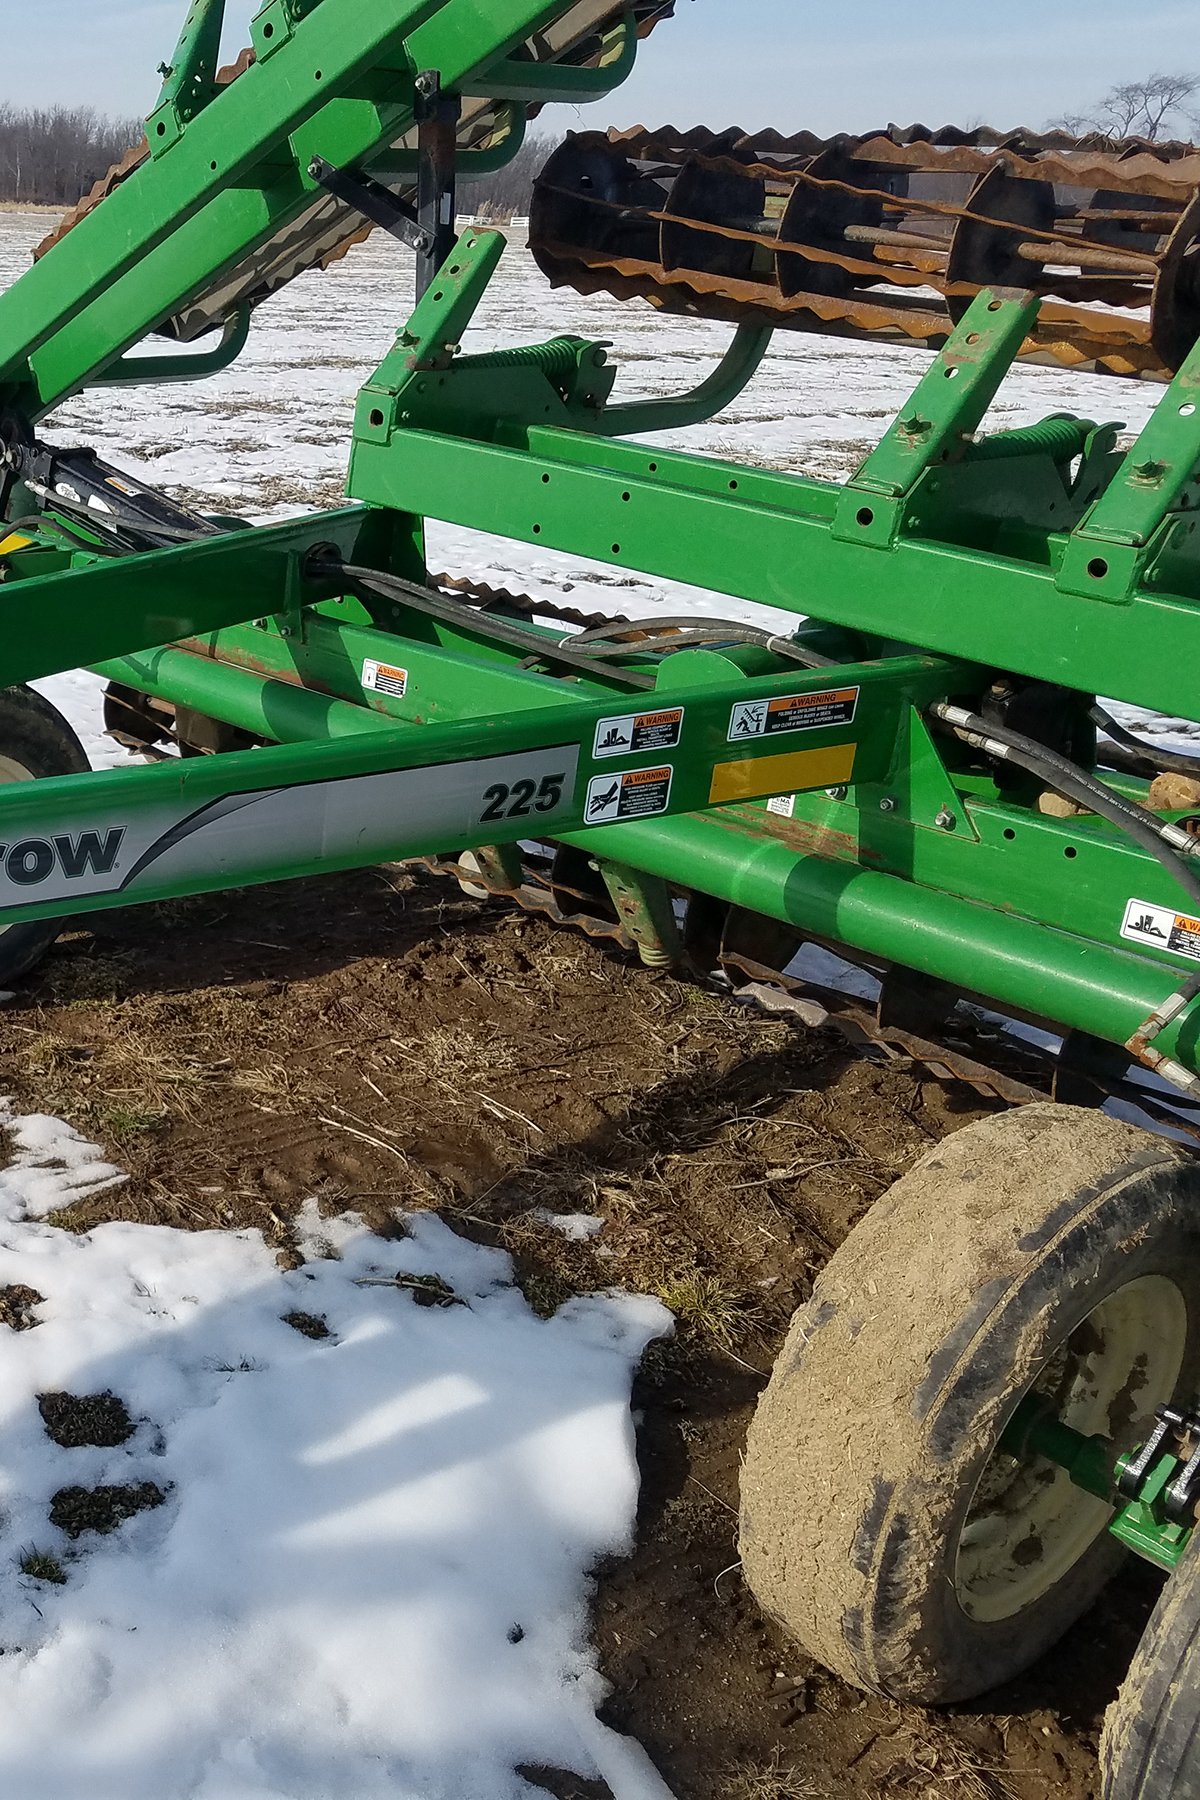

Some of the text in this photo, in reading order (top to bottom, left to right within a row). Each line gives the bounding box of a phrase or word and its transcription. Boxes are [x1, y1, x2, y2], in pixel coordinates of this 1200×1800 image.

[798, 693, 836, 706] WARNING
[647, 712, 679, 725] WARNING
[634, 770, 668, 782] WARNING
[477, 772, 566, 824] 225
